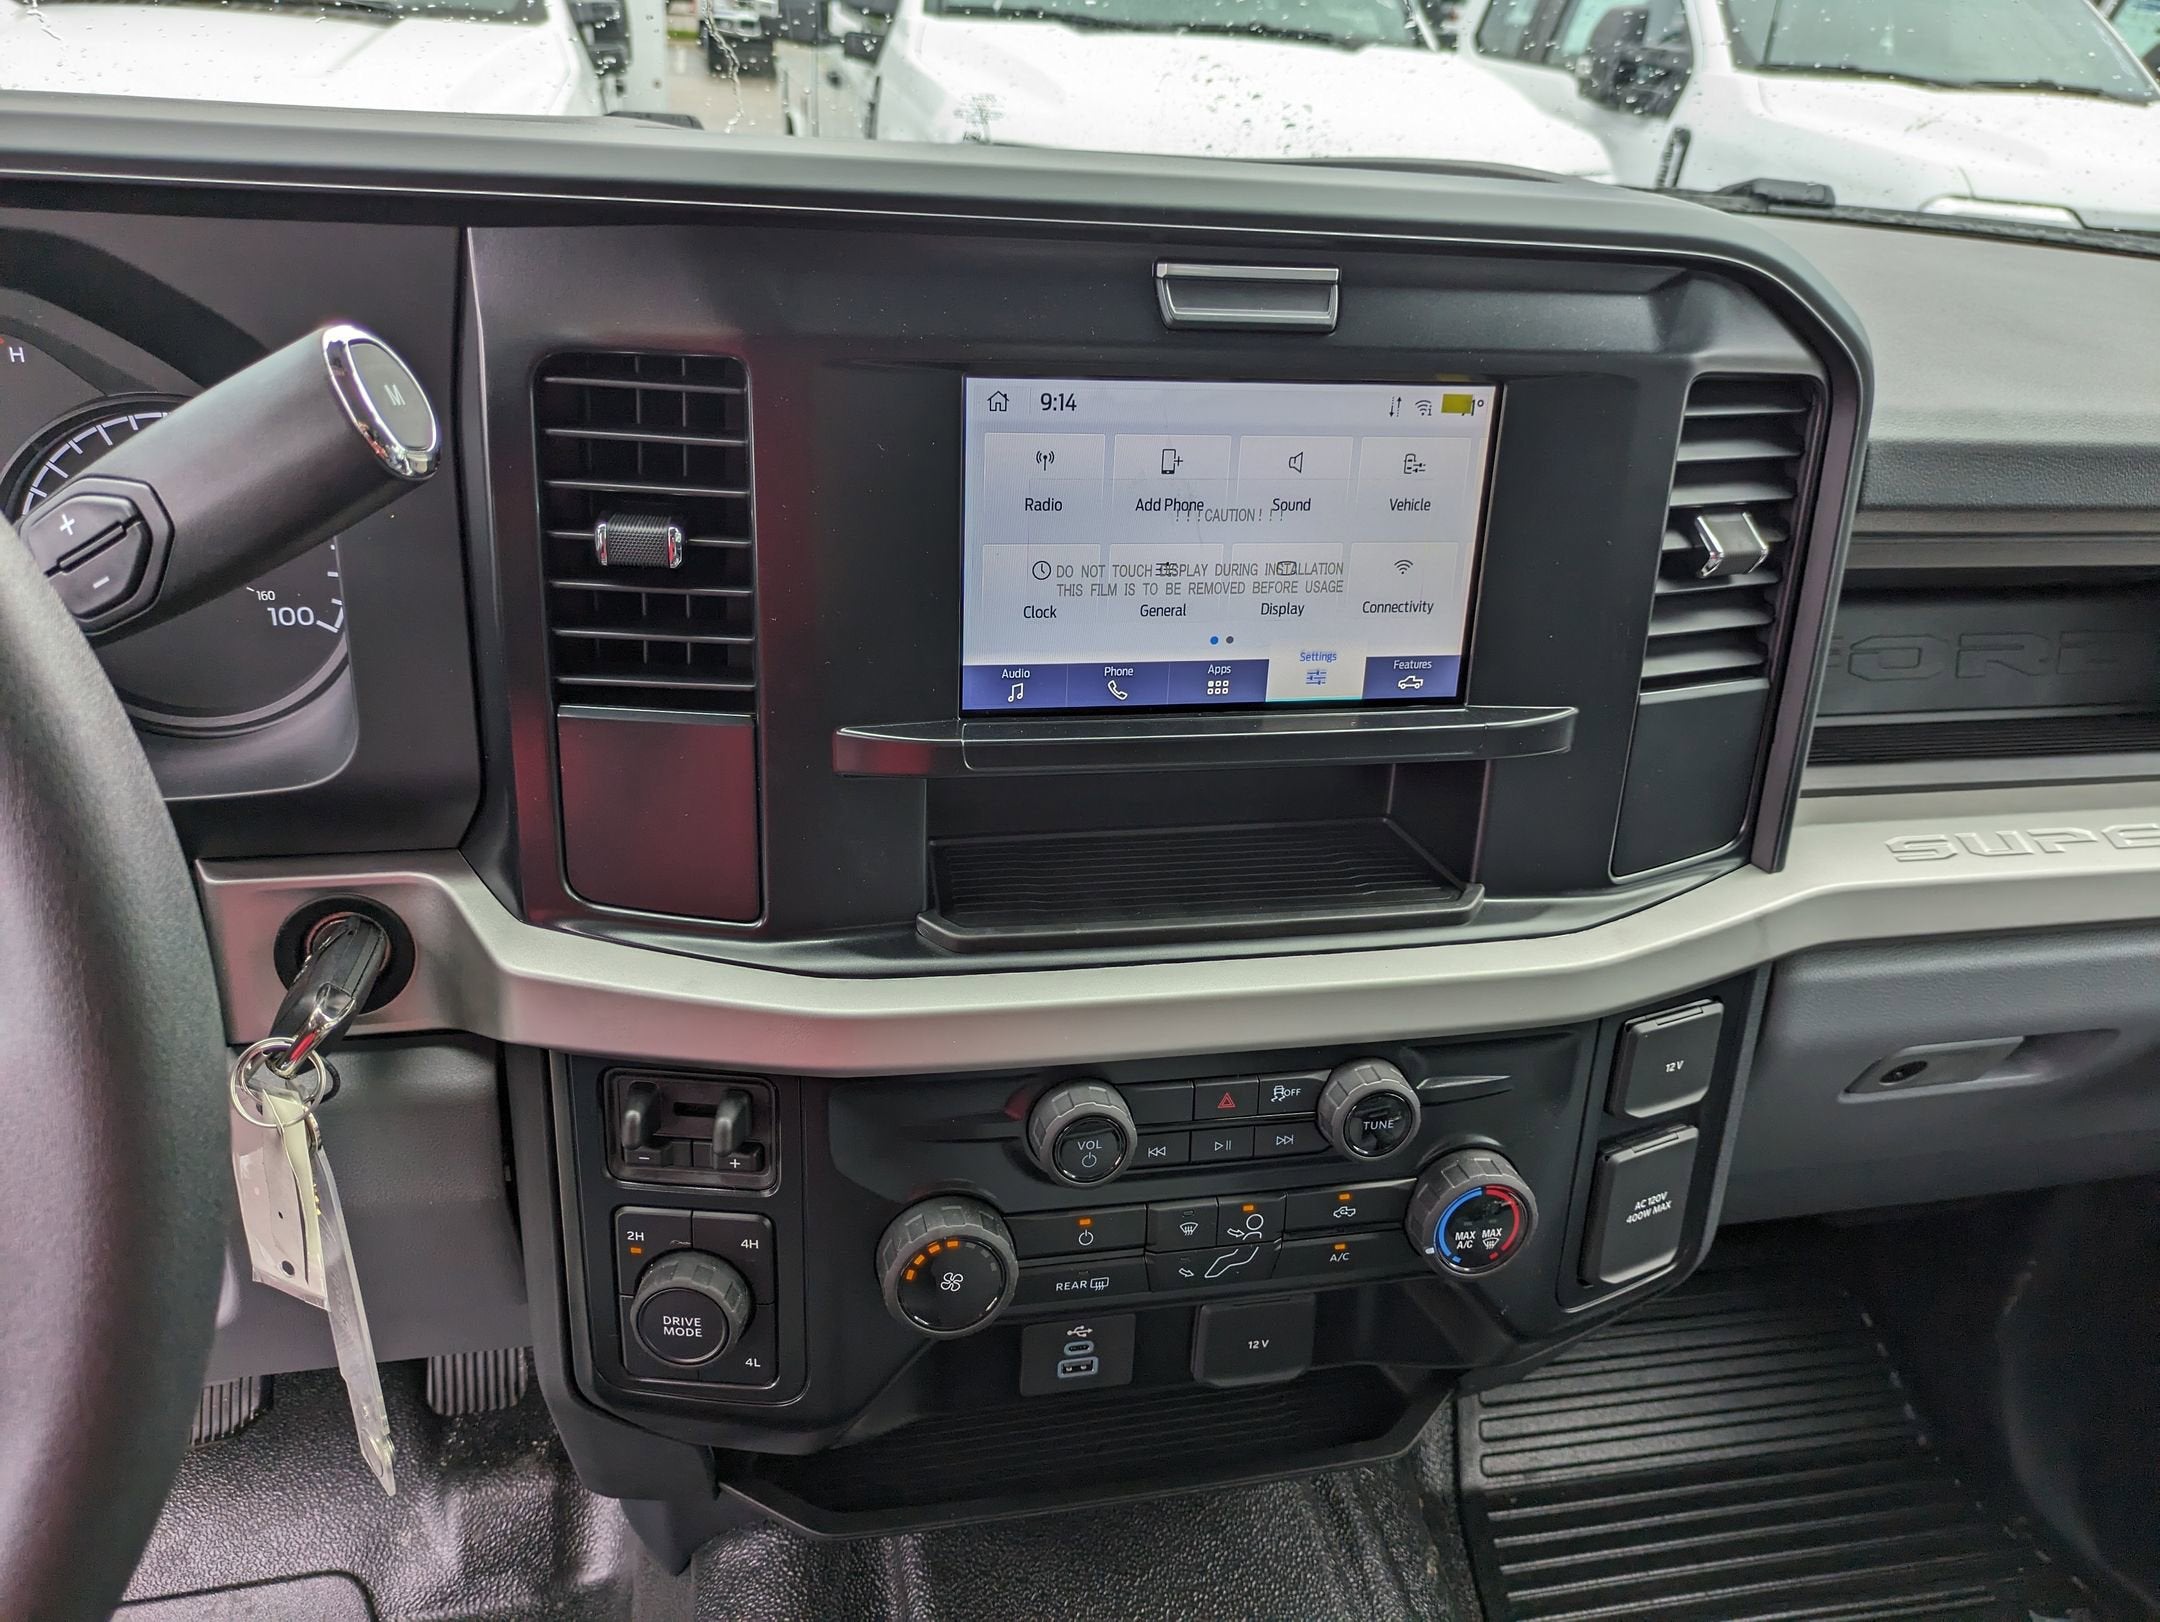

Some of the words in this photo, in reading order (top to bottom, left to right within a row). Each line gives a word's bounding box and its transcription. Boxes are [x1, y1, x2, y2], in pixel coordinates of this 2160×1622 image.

[9, 346, 25, 363] H
[384, 384, 406, 406] M
[1040, 392, 1077, 411] 9:14
[1024, 497, 1063, 512] Radio
[1135, 498, 1161, 512] Add
[1164, 498, 1204, 512] Phone
[1272, 498, 1311, 512] Sound
[1390, 498, 1431, 512] Vehicle
[1056, 565, 1074, 578] DO
[1081, 564, 1106, 578] NOT
[1112, 564, 1152, 577] TOUCH
[1158, 563, 1209, 577] DISPLAY
[1215, 563, 1258, 576] DURING
[1264, 562, 1344, 576] INSTALLATION
[1057, 583, 1083, 597] THIS
[1090, 583, 1118, 596] FILM
[1124, 583, 1136, 596] IS
[1143, 583, 1158, 596] TO
[1165, 582, 1182, 595] BE
[1188, 581, 1246, 595] REMOVED
[1252, 580, 1299, 594] BEFORE
[1305, 580, 1344, 594] USAGE
[256, 590, 276, 601] 160
[1023, 605, 1057, 619] Clock
[1140, 603, 1187, 617] General
[1261, 602, 1305, 617] Display
[1362, 600, 1434, 614] Connectivity
[267, 606, 315, 626] 100
[1300, 651, 1337, 663] Settings
[1207, 664, 1231, 676] Apps
[1393, 659, 1432, 670] Features
[1001, 668, 1031, 679] Audio
[1104, 666, 1134, 677] Phone
[1284, 1088, 1301, 1097] OFF
[1363, 1120, 1394, 1131] TUNE
[1077, 1139, 1103, 1150] VOL
[1634, 1198, 1647, 1210] AC
[1648, 1191, 1669, 1206] 120V
[1626, 1208, 1652, 1223] 400W
[1652, 1200, 1672, 1214] MAX
[626, 1231, 645, 1241] 2H
[1455, 1230, 1476, 1241] MAX
[1481, 1228, 1502, 1239] MAX
[740, 1239, 759, 1250] 4H
[1456, 1240, 1473, 1249] A/C
[1329, 1252, 1350, 1263] A/C
[1055, 1280, 1088, 1291] REAR
[663, 1315, 702, 1327] DRIVE
[663, 1326, 703, 1338] MODE
[745, 1358, 761, 1368] 4L
